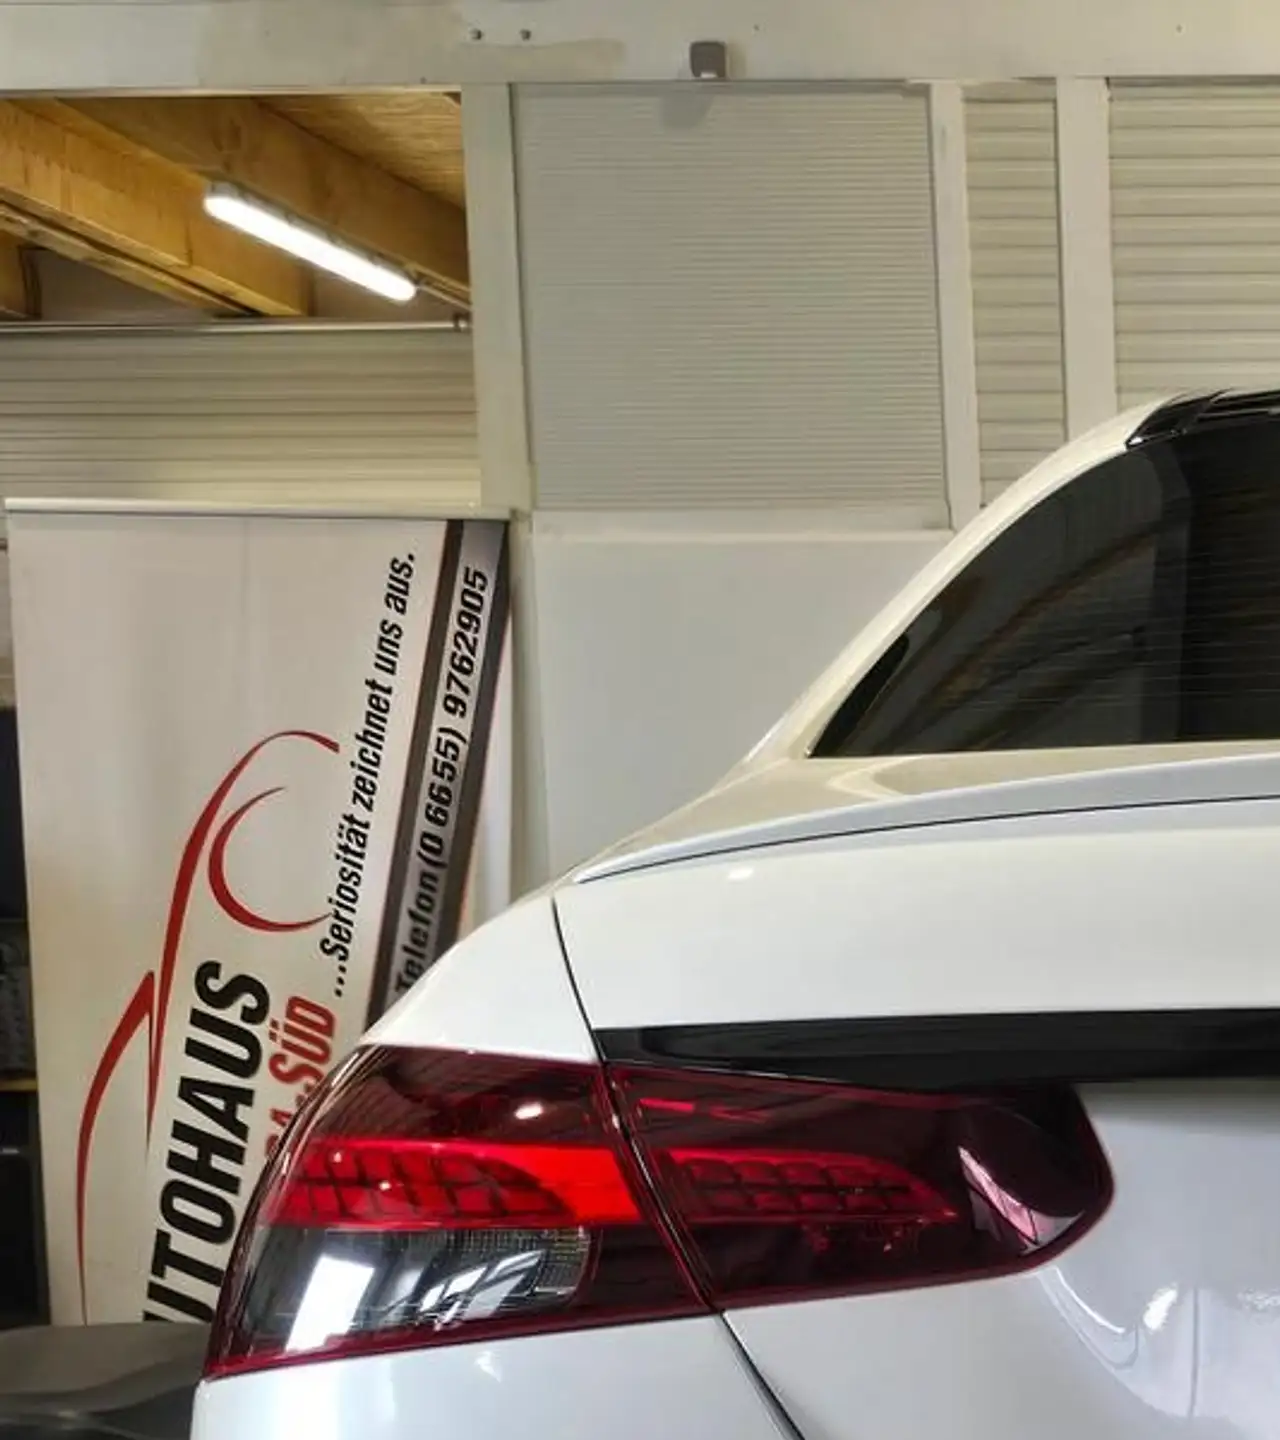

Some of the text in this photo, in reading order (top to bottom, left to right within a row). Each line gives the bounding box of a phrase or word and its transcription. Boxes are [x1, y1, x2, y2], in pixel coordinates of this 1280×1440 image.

[319, 552, 416, 997] ...Seriosität zeichnet uns aus.
[442, 565, 489, 719] 9762905
[143, 960, 270, 1323] UTOHAUS
